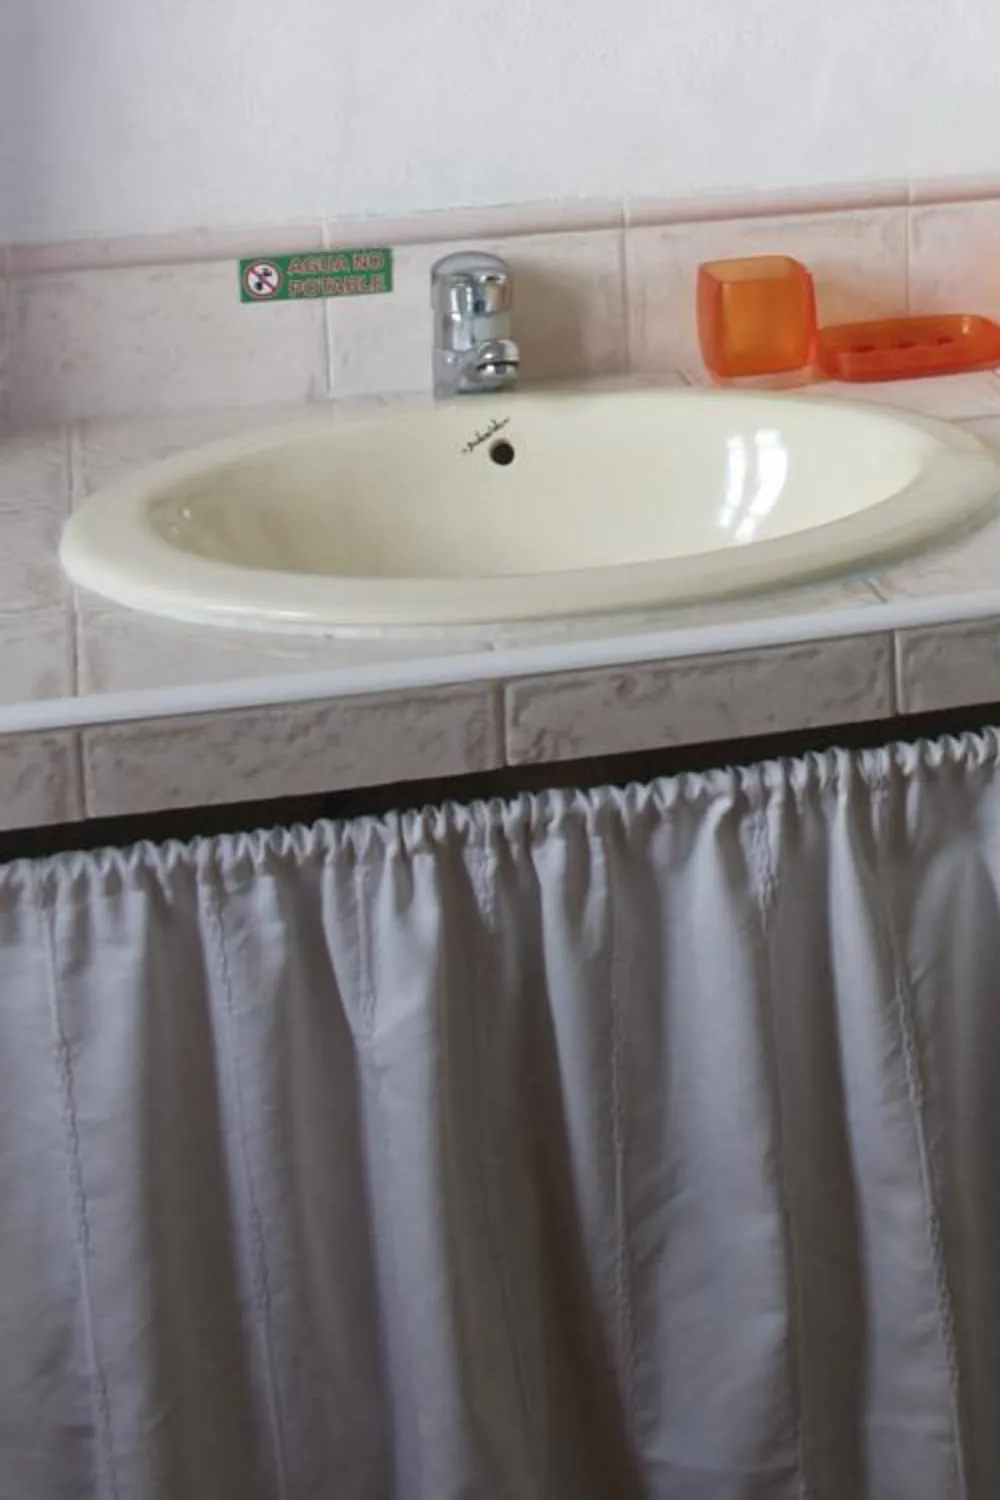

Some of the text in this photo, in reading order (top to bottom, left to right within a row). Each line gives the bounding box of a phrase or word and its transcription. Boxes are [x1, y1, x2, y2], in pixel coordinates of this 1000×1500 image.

[287, 252, 385, 274] AGUA NO
[287, 274, 384, 297] POTABLE
